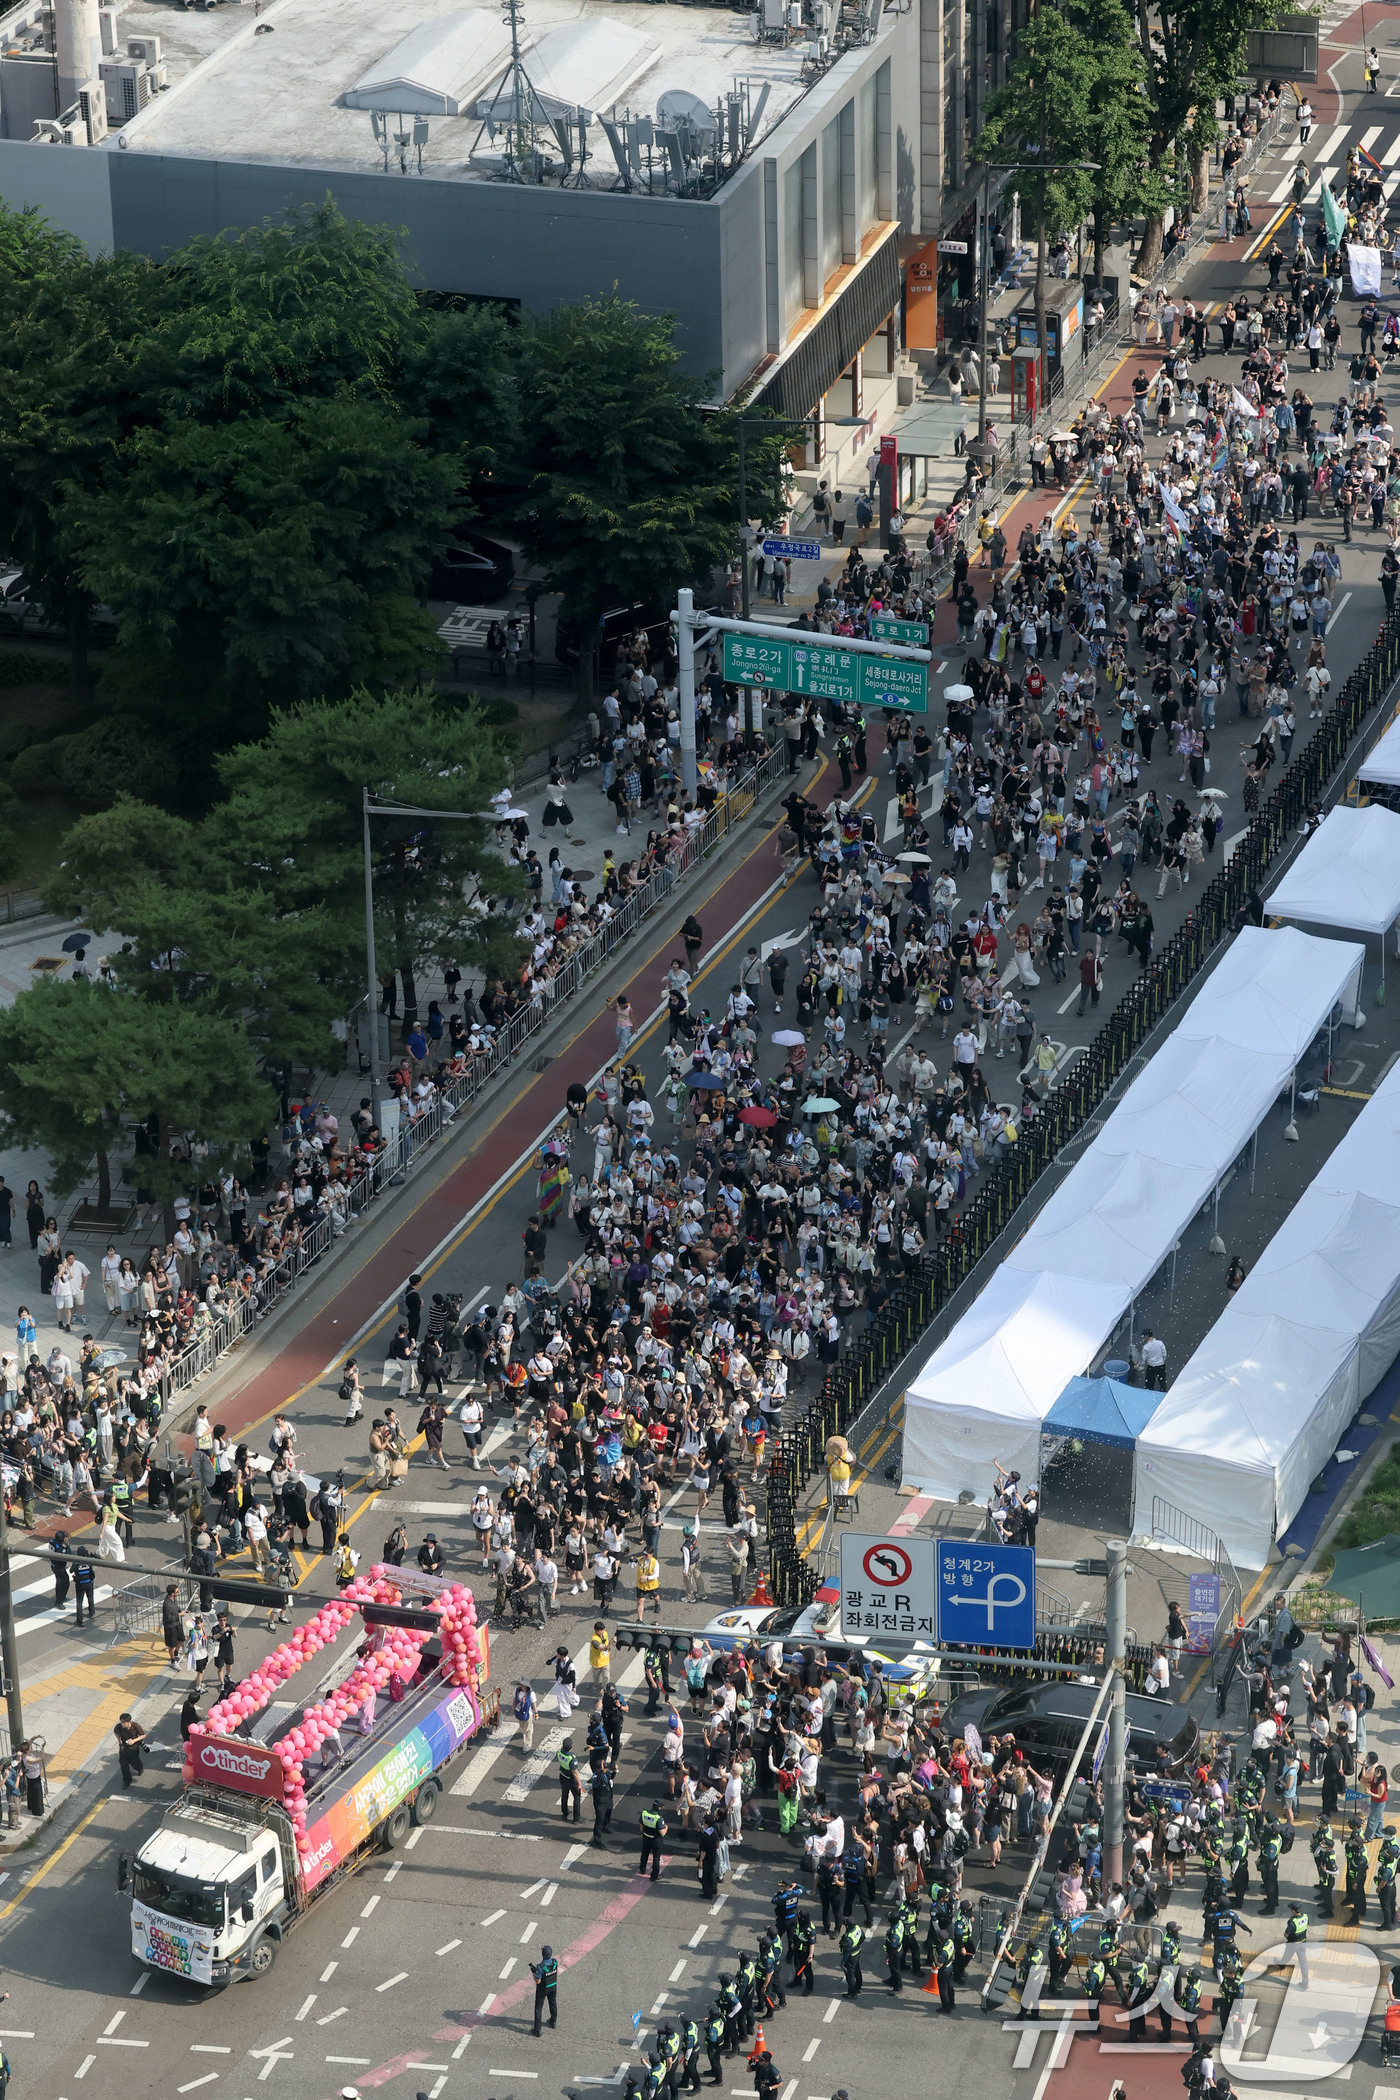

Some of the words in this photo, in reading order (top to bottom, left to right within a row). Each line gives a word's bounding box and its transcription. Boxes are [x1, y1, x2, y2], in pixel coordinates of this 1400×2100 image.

[940, 243, 963, 252] PIZZA
[780, 542, 819, 554] 우정국로2길
[731, 643, 783, 664] 종로2가
[810, 651, 852, 669] 숭례문
[731, 658, 759, 670] Jongno
[810, 671, 849, 683] Sungnyemun
[865, 666, 922, 685] 세종대로사거리
[809, 680, 853, 698] 을지로1가
[864, 678, 911, 693] Sejong-daero
[910, 685, 922, 695] Jct
[887, 694, 894, 703] 6
[943, 1557, 995, 1574] 청계2가
[1195, 1595, 1215, 1603] 대기실
[846, 1611, 933, 1634] 좌회전금지
[217, 1753, 264, 1777] tinder
[309, 1838, 333, 1867] tinder
[150, 1926, 188, 1950] SEOUL
[150, 1938, 188, 1962] QUEER
[146, 1947, 192, 1975] PARADE
